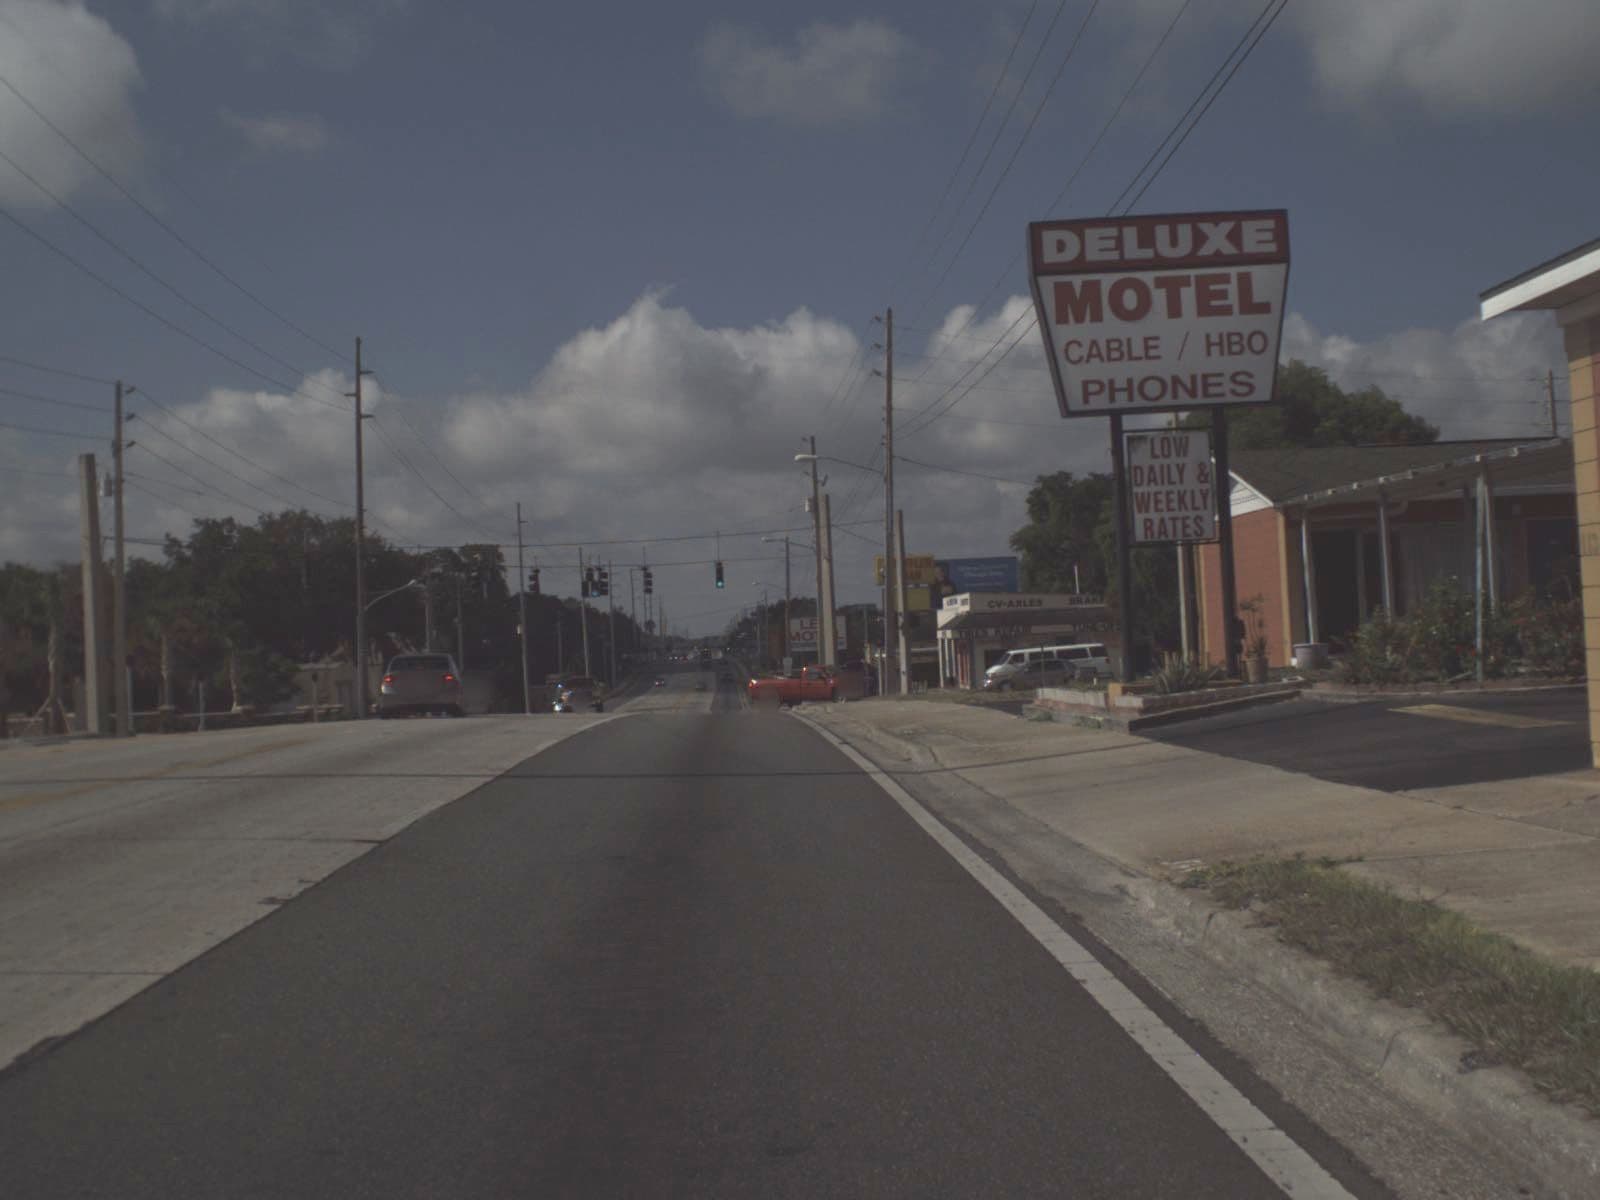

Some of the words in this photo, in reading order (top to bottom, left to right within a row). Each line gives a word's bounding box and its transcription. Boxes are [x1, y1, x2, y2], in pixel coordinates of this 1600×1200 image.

[1041, 219, 1277, 264] DELUXE
[1053, 271, 1271, 326] MOTEL
[1064, 335, 1162, 365] CABLE
[1205, 330, 1269, 357] HBO
[1080, 370, 1256, 405] PHONES
[1149, 435, 1189, 459] LOW
[1133, 463, 1185, 486] DAILY
[1197, 461, 1209, 484] &
[1134, 488, 1209, 514] WEEKLY
[1143, 515, 1204, 540] RATES
